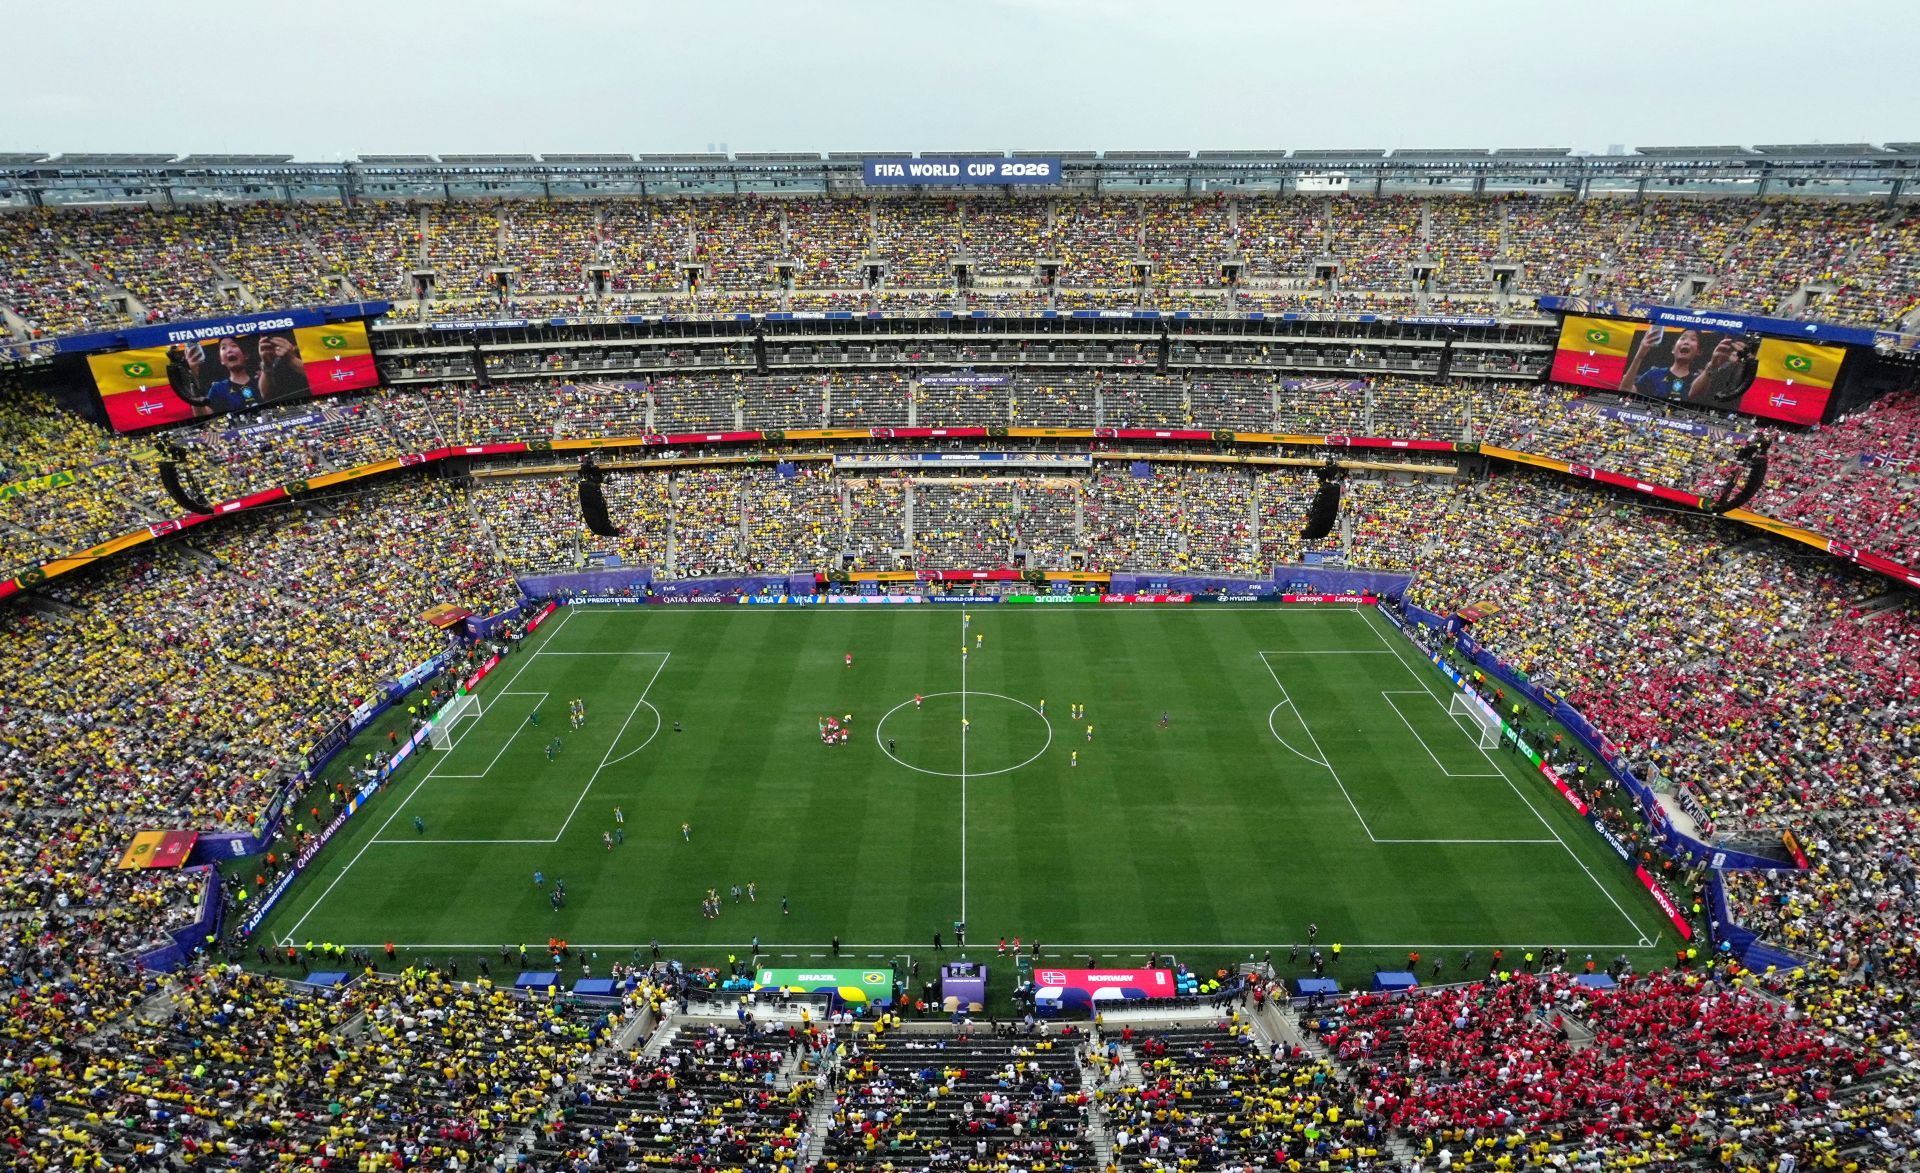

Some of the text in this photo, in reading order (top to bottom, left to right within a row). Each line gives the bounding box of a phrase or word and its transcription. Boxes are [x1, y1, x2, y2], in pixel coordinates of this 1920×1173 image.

[874, 164, 1050, 177] FIFA WORLD CUP 2026
[1660, 313, 1676, 321] FIFA
[1675, 314, 1701, 324] WORLD
[1716, 319, 1743, 328] 2026
[168, 317, 295, 342] FIFA WORLD CUP 2026
[290, 415, 313, 426] 2026
[1617, 410, 1631, 419] FIFA
[1668, 421, 1693, 431] 2026
[568, 597, 586, 605] ADI
[755, 596, 813, 604] VISA VISA
[1035, 595, 1073, 603] aramco
[1105, 594, 1187, 603] Coca-Cola Coca-Cola Coca-Cola
[1443, 664, 1455, 680] VISA
[361, 778, 379, 798] VISA
[297, 811, 347, 869] QATAR AIRWAYS
[1603, 830, 1629, 861] HYUNDAI
[1650, 883, 1675, 918] Lenovo
[249, 912, 263, 931] ADI
[1087, 974, 1134, 982] NORWAY
